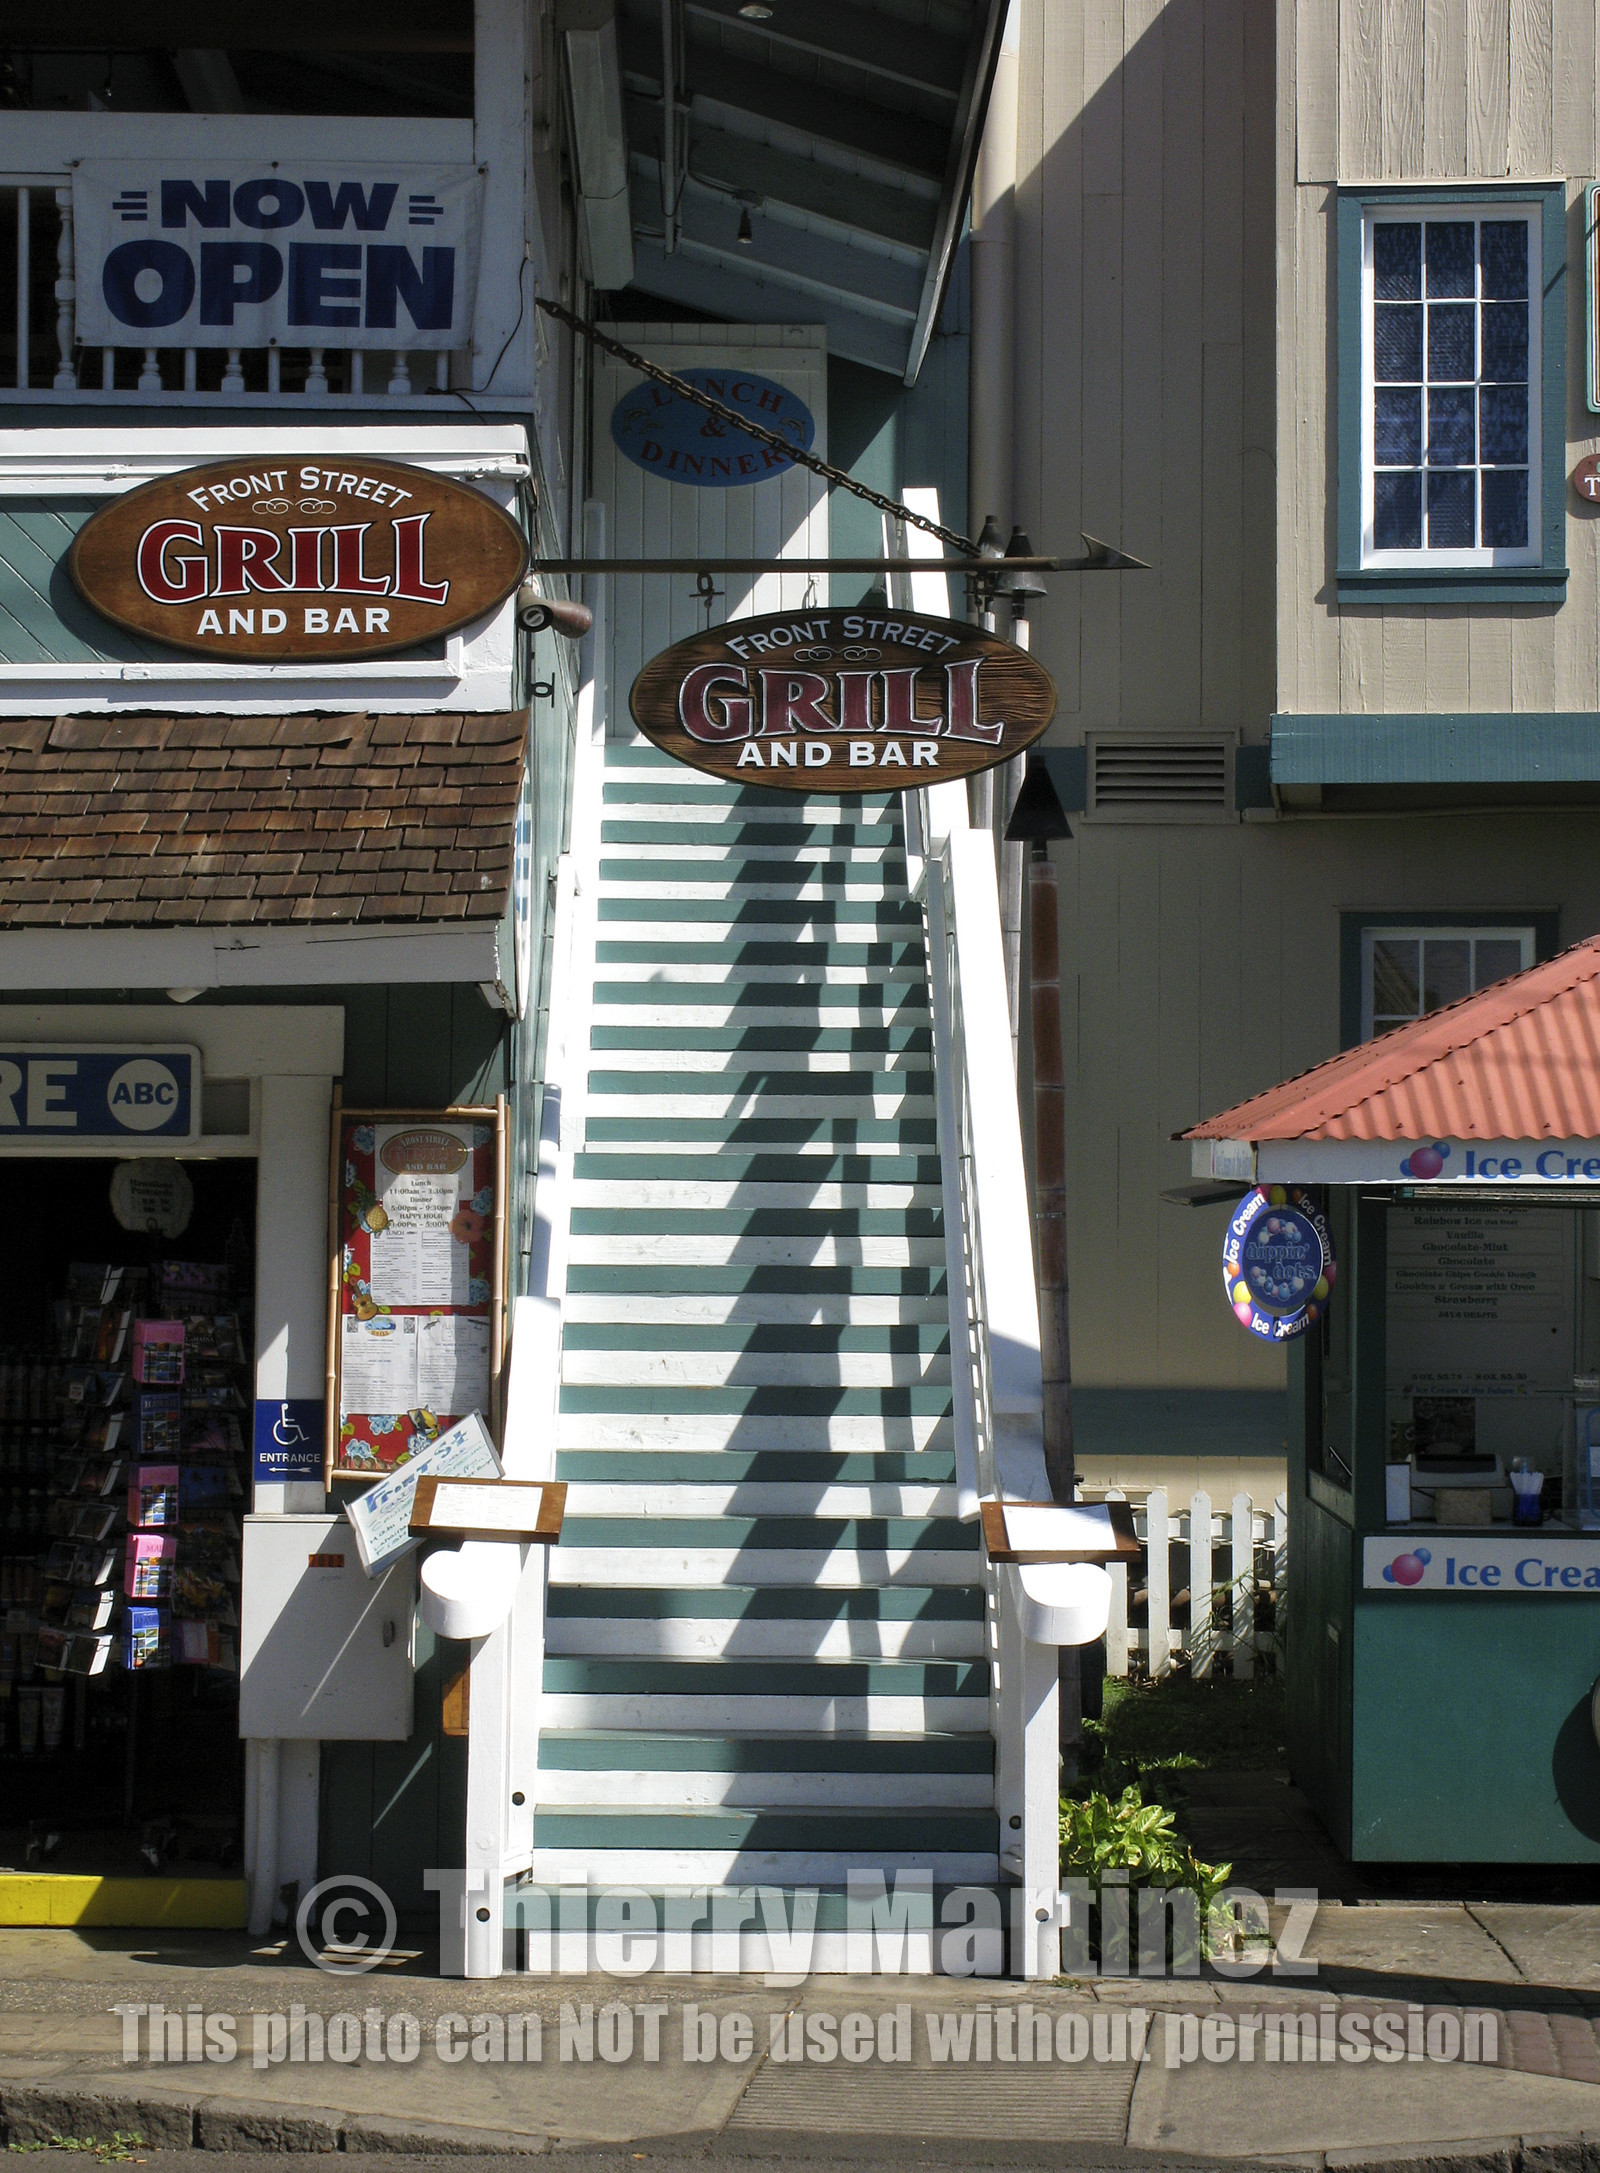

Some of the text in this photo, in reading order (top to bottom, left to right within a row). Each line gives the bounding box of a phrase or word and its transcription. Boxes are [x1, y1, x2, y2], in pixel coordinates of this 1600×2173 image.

[161, 178, 399, 231] NOW
[102, 239, 455, 330] OPEN
[700, 416, 725, 438] &
[640, 440, 786, 477] DINNER
[187, 466, 413, 512] FRONT STREET
[137, 511, 449, 605] GRILL
[197, 608, 391, 635] AND BAR
[725, 616, 960, 660] FRONT STREET
[679, 657, 1004, 745] GRILL
[737, 741, 940, 767] AND BAR
[111, 1082, 174, 1105] ABC
[1465, 1150, 1522, 1179] Ice
[1232, 1192, 1266, 1236] Cream
[1414, 1216, 1460, 1225] Rainbow
[1464, 1216, 1481, 1225] Ice
[1298, 1192, 1333, 1267] Ice Cream
[1447, 1231, 1484, 1240] Vanilla
[1225, 1238, 1241, 1266] Ice
[1438, 1257, 1495, 1265] Chocolate
[1272, 1261, 1317, 1280] dots
[1396, 1270, 1442, 1278] Chocolate
[1473, 1270, 1505, 1278] Cookie
[1395, 1282, 1436, 1290] Cookies
[1450, 1282, 1482, 1290] Cream
[1486, 1282, 1507, 1290] with
[1434, 1295, 1498, 1305] Strawberry
[1251, 1312, 1310, 1339] Ice Cream
[259, 1453, 320, 1463] ENTRANCE
[1446, 1557, 1600, 1587] Ice Crea
